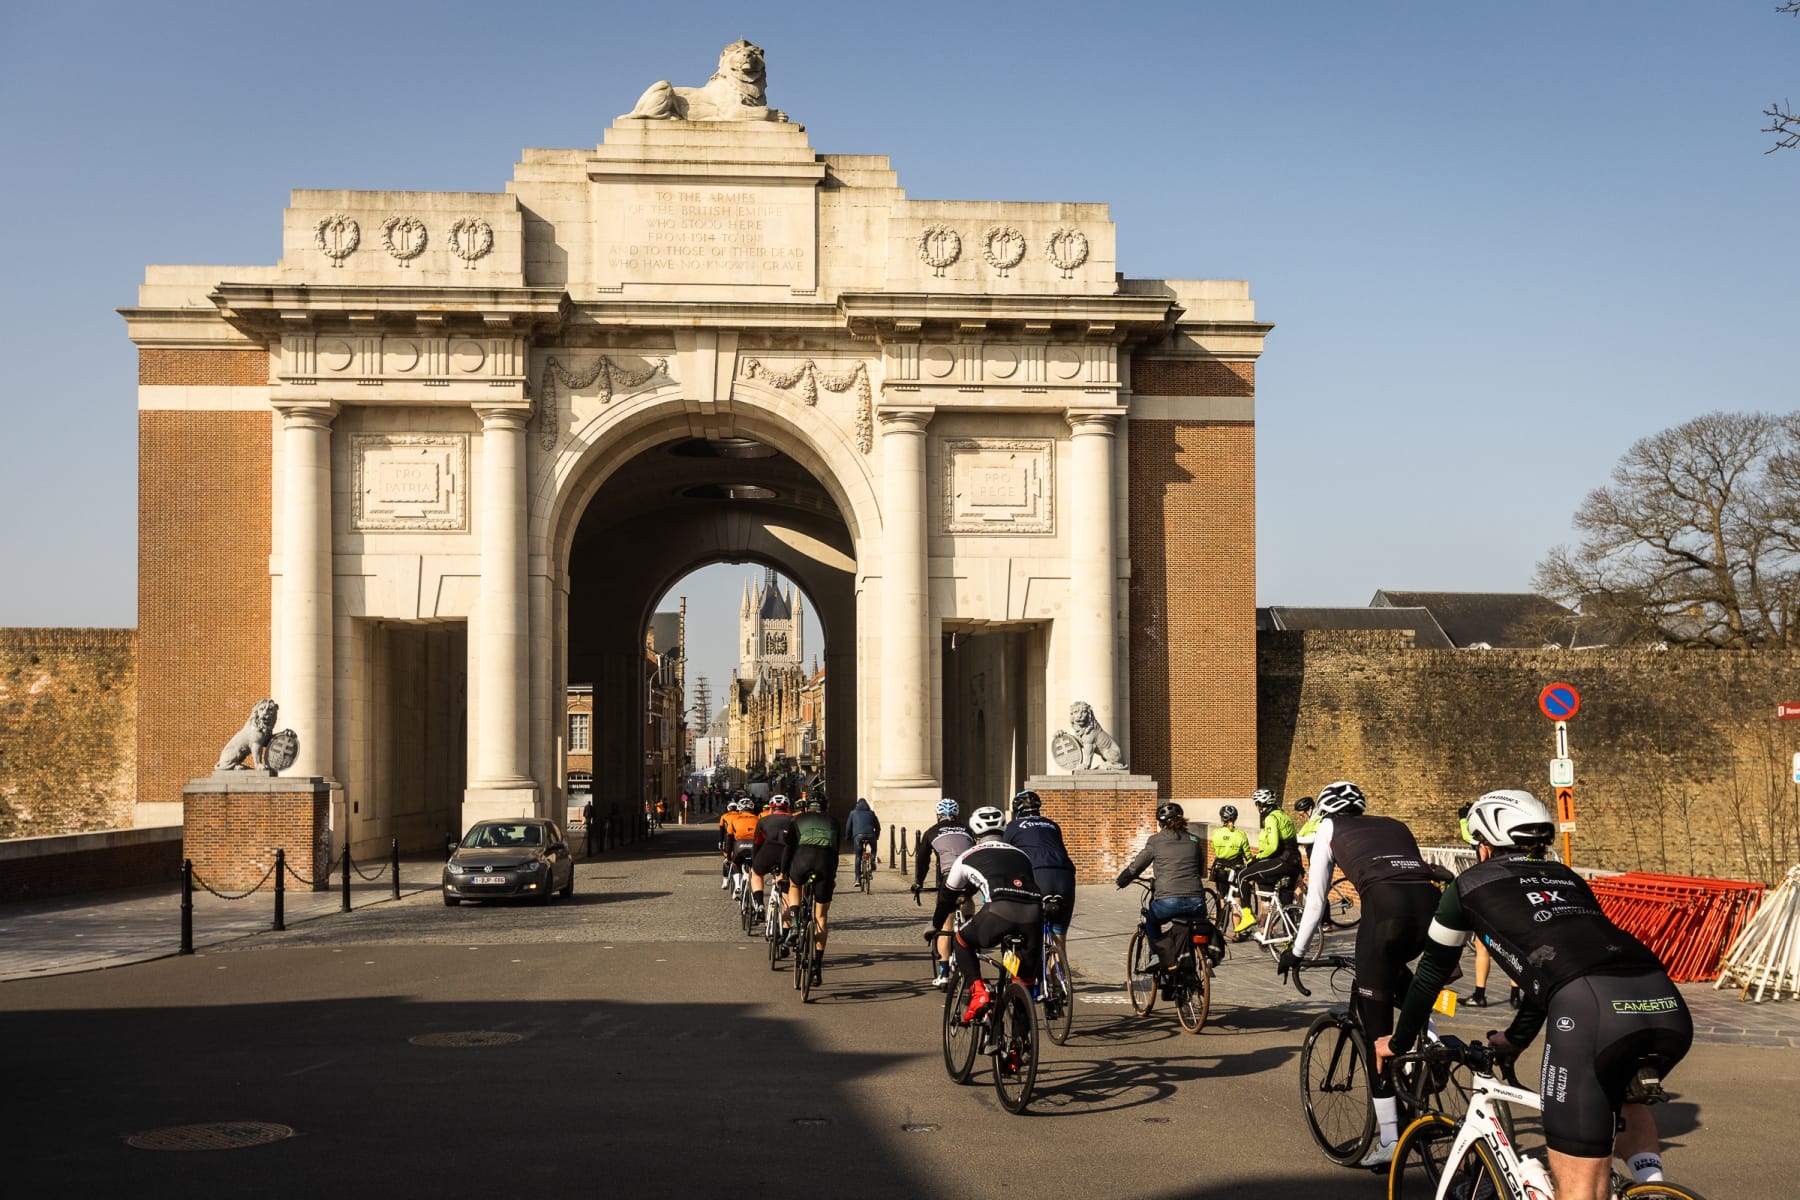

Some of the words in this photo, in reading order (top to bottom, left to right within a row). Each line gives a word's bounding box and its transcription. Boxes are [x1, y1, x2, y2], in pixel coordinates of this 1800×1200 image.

[656, 192, 672, 202] TO
[678, 192, 701, 202] THE
[711, 193, 755, 203] ARMIES
[653, 206, 673, 216] THE
[681, 206, 731, 217] BRITISH
[647, 219, 676, 229] WHO
[682, 220, 722, 230] STOOD
[729, 220, 763, 231] HERE
[648, 232, 686, 243] FROM
[721, 233, 737, 243] TO
[644, 246, 660, 256] TO
[666, 246, 704, 257] THOSE
[711, 247, 726, 257] OF
[733, 247, 767, 257] THEIR
[771, 248, 803, 258] DEAD
[609, 259, 639, 269] WHO
[644, 259, 675, 270] HAVE
[681, 260, 701, 270] NO
[763, 261, 804, 272] GRAVE
[385, 482, 431, 493] PATRIA
